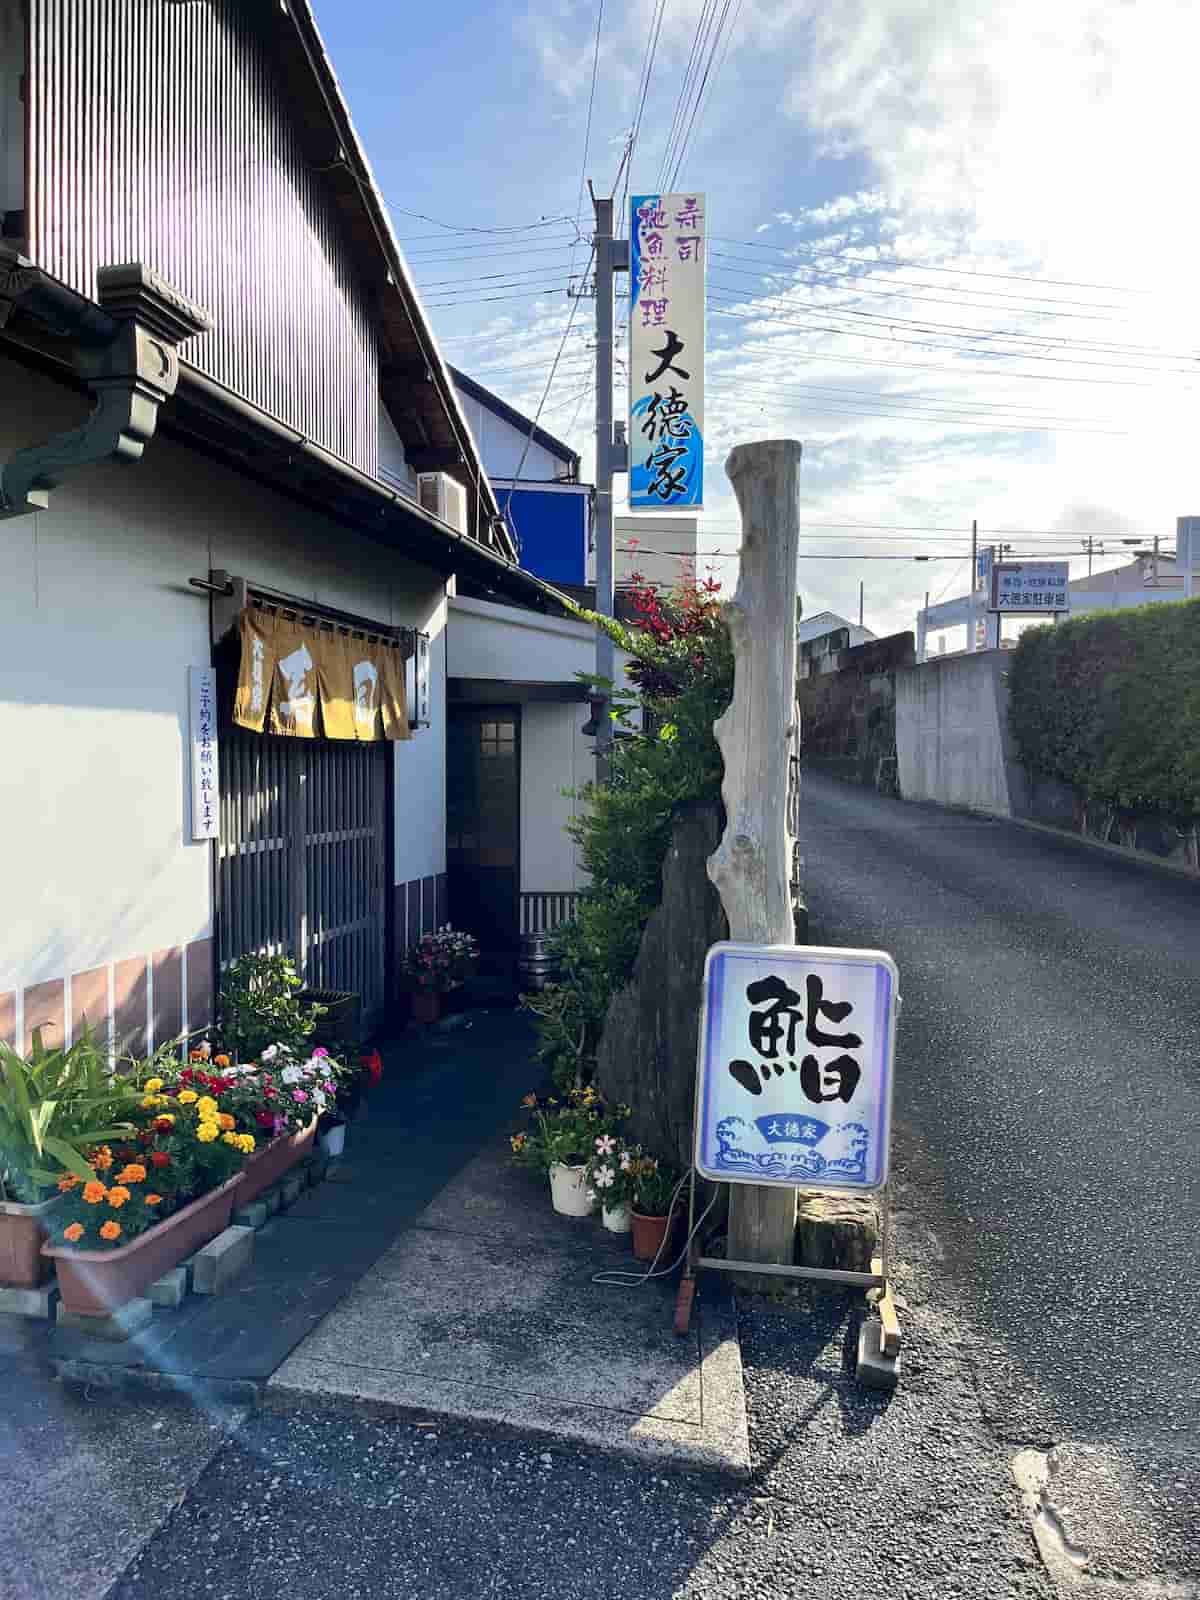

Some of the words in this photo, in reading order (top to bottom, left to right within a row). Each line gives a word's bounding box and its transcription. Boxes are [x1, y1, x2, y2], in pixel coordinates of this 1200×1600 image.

[638, 199, 669, 327] 地魚料理
[675, 198, 703, 263] 寿司
[645, 330, 690, 499] 大徳家
[728, 973, 863, 1104] 鮨
